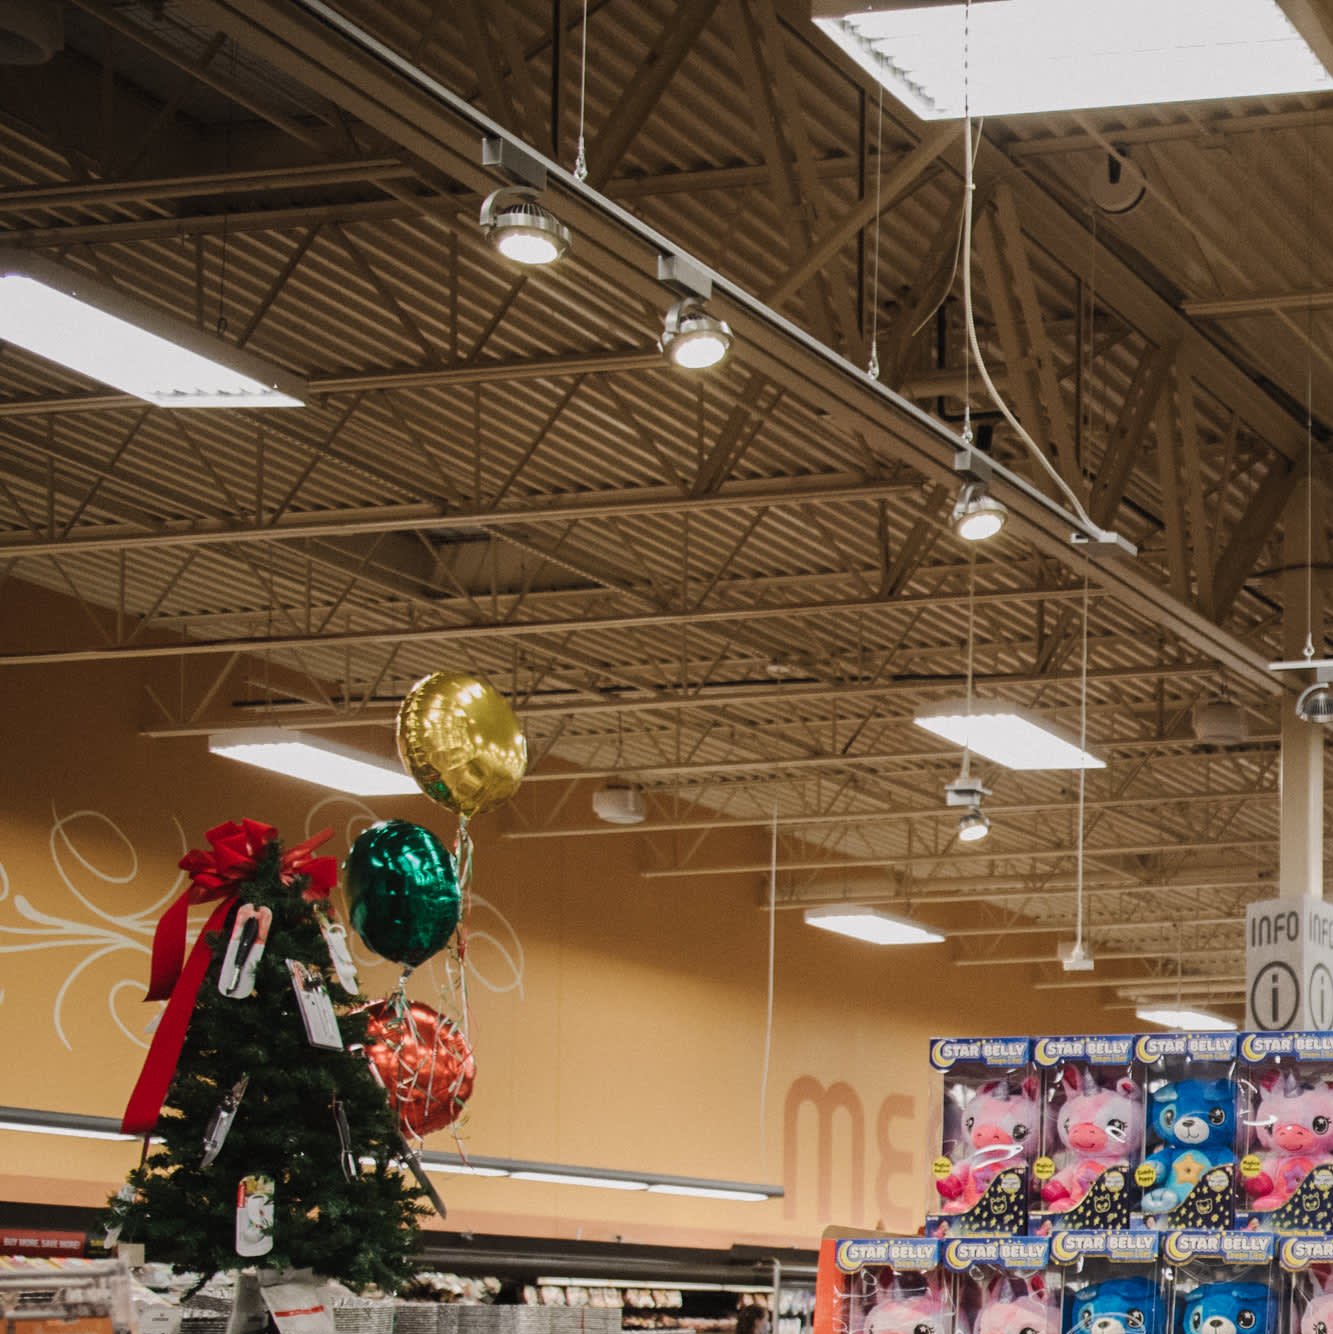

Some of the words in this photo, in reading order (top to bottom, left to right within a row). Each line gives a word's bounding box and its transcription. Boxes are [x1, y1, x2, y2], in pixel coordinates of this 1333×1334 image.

[1252, 911, 1299, 947] INFO
[944, 1043, 979, 1058] STAR
[983, 1041, 1025, 1057] BELLY
[1048, 1041, 1083, 1056] STAR
[1088, 1041, 1129, 1056] BELLY
[1148, 1038, 1185, 1052] STAR
[1189, 1036, 1232, 1052] BELLY
[1254, 1038, 1290, 1052] STAR
[783, 1074, 915, 1229] ME
[1065, 1236, 1104, 1250] STAR
[1109, 1235, 1154, 1250] BELLY
[1179, 1236, 1218, 1250] STAR
[1223, 1236, 1269, 1251] BELLY
[1295, 1243, 1333, 1257] STAR
[850, 1246, 885, 1259] STAR
[891, 1245, 935, 1258] BELLY
[958, 1245, 997, 1259] STAR
[1002, 1244, 1046, 1258] BELLY
